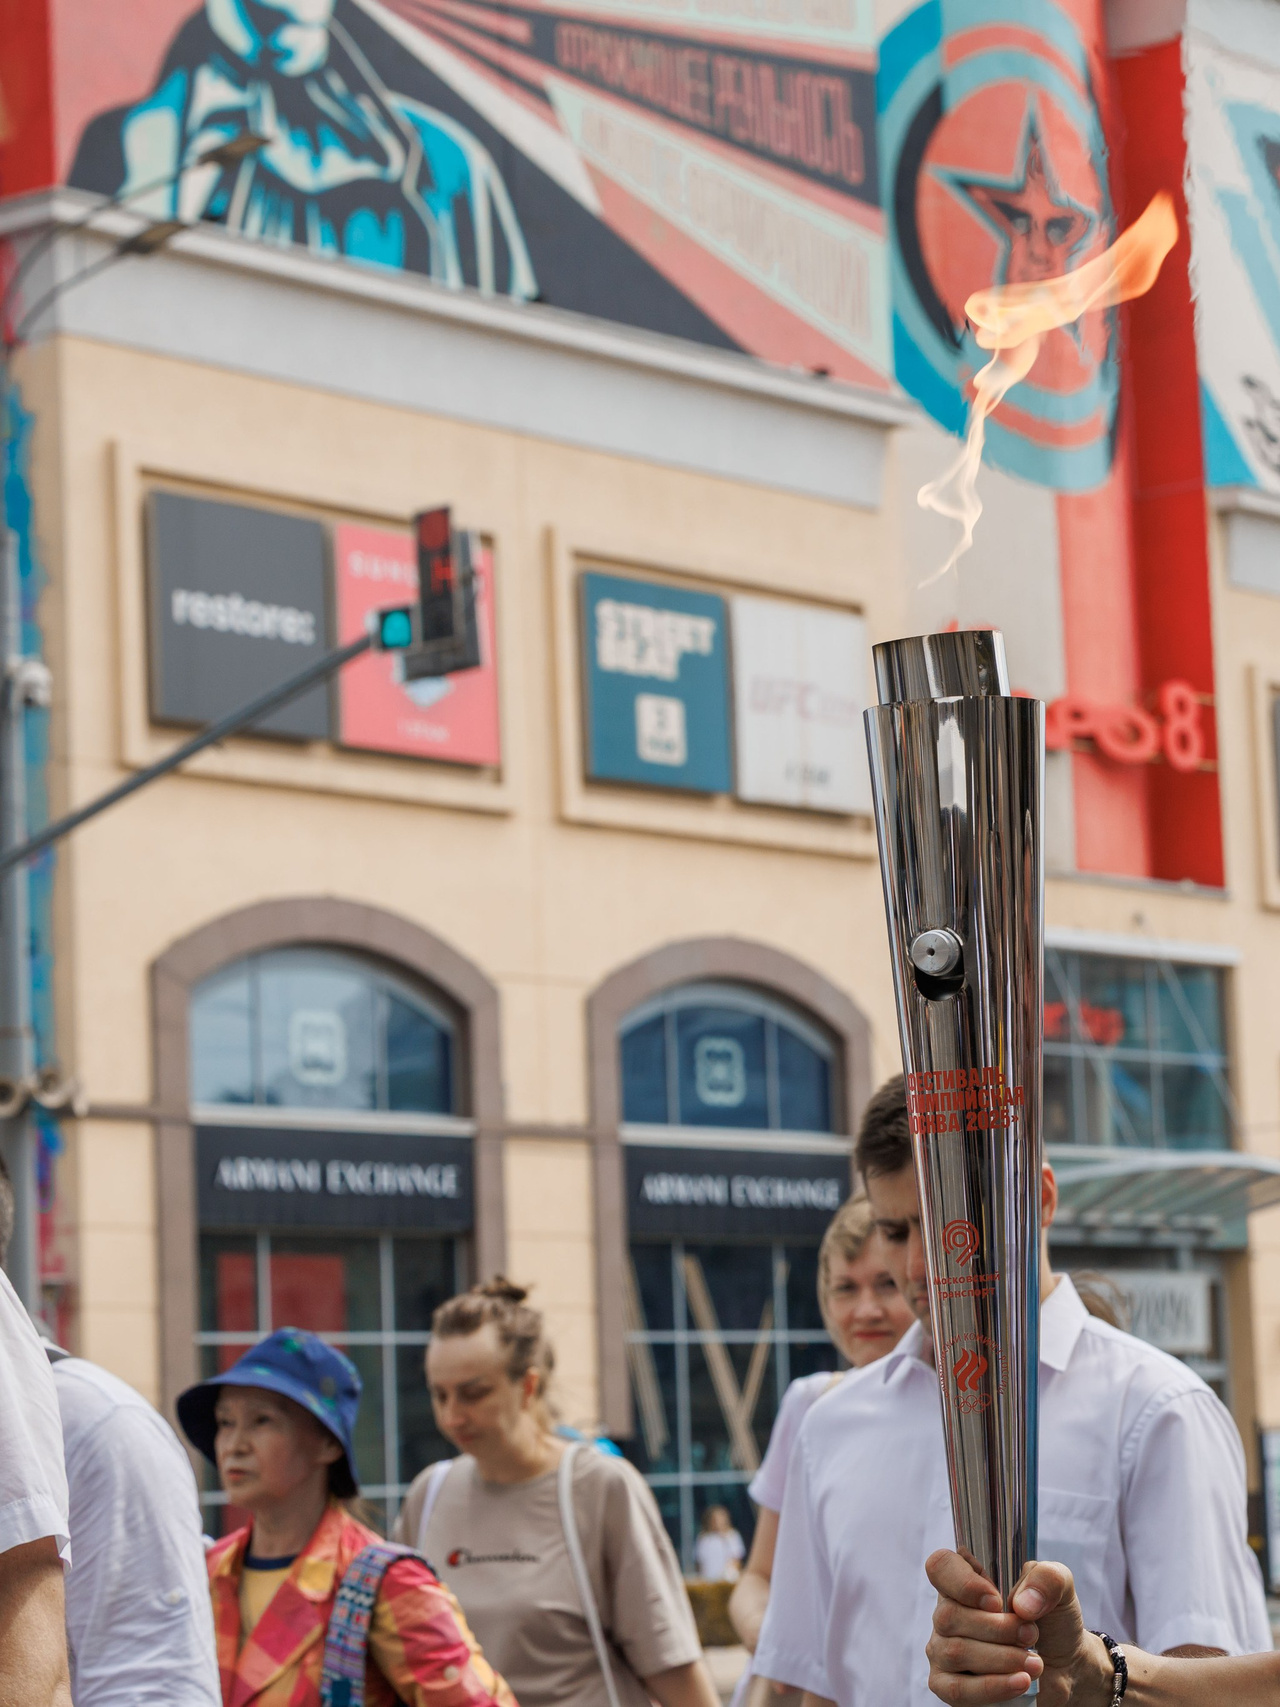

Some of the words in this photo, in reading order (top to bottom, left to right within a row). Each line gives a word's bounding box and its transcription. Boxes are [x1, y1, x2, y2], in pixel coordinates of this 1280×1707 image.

[907, 1066, 1006, 1092] ФЕСТИВАЛЬ
[908, 1112, 961, 1135] МОСКВА
[214, 1155, 321, 1193] ARMANI
[326, 1159, 459, 1199] EXCHANGE
[640, 1171, 729, 1207] ARMANI
[731, 1175, 840, 1211] EXCHANGE
[934, 1271, 1000, 1285] Московский
[938, 1287, 995, 1299] транспорт
